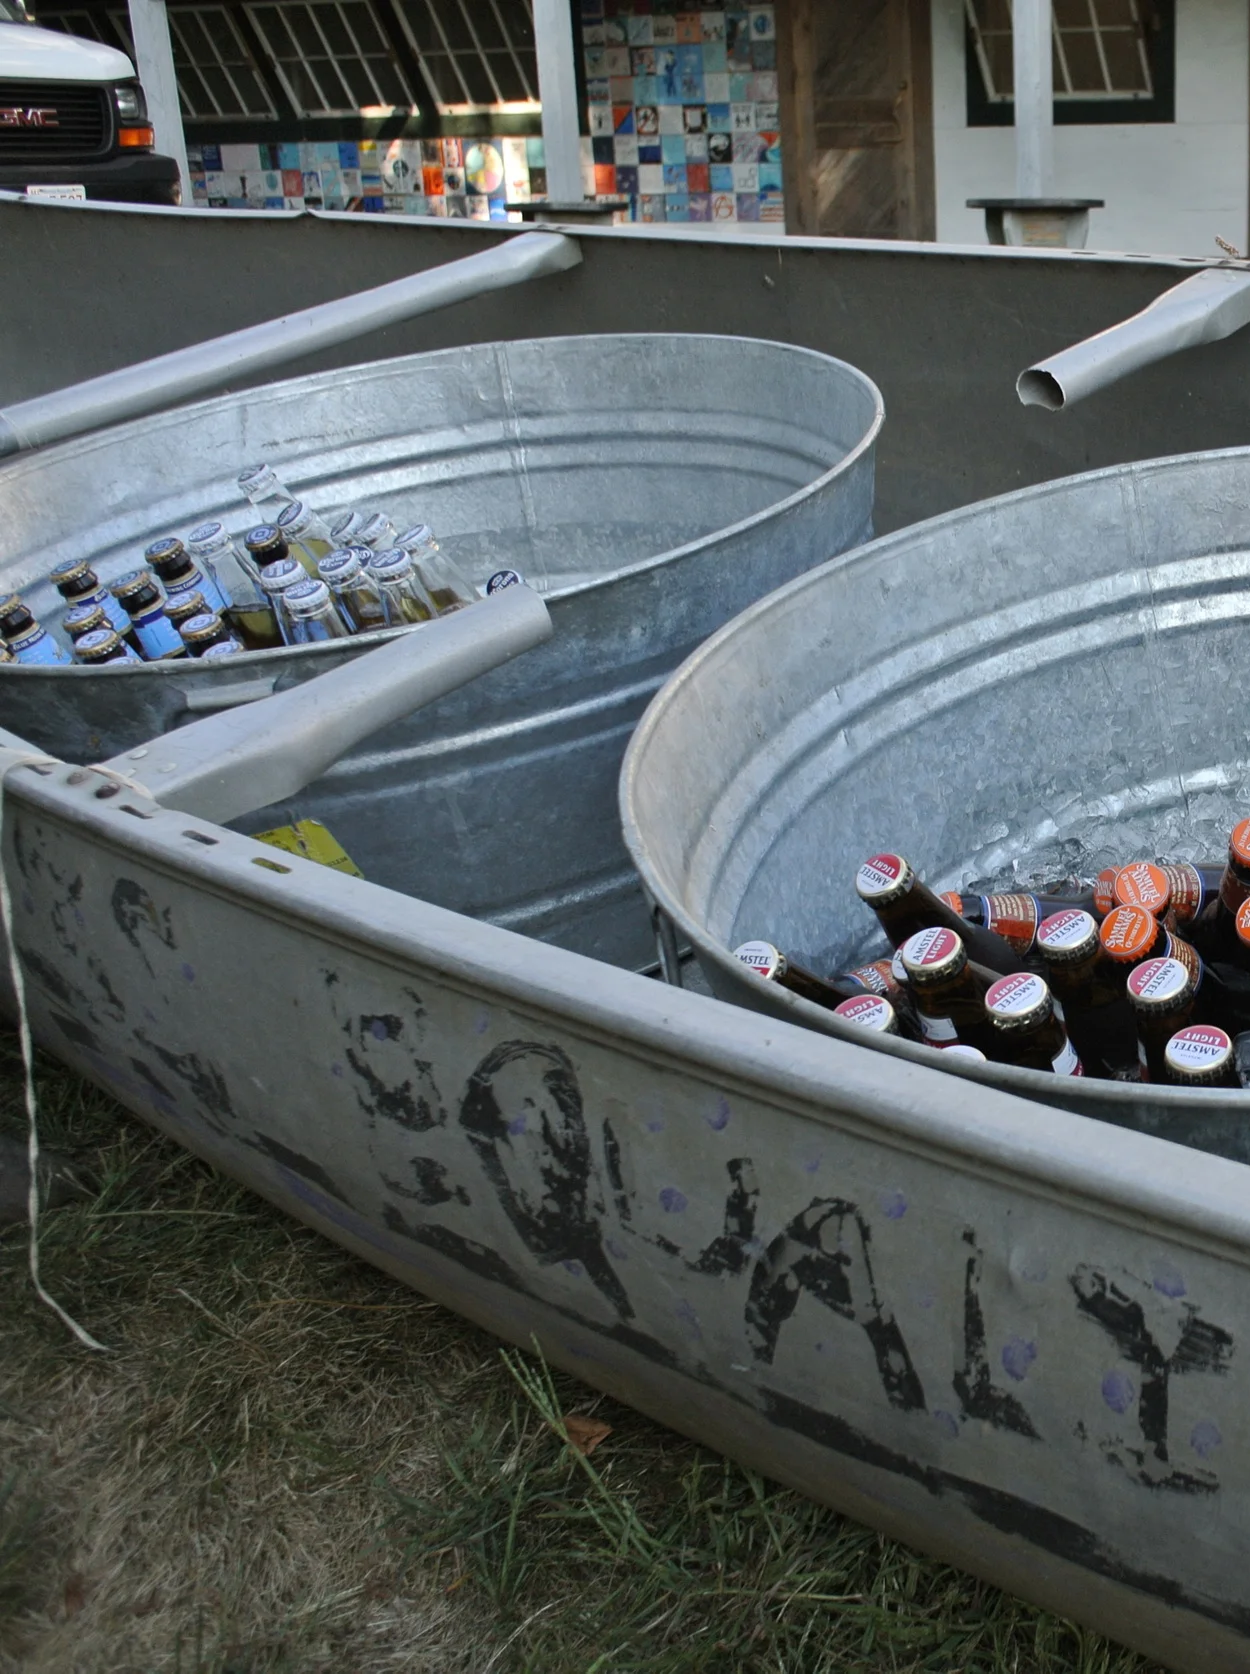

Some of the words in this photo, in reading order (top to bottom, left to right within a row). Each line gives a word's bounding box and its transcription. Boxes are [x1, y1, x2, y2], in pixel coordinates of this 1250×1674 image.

[0, 108, 59, 127] GMC
[861, 866, 890, 886] AMSTEL
[872, 859, 896, 876] LIGHT
[1045, 913, 1075, 935] LIGHT
[1049, 915, 1085, 943] AMSTEL
[913, 928, 938, 961] AMSTEL
[927, 934, 947, 960] LIGHT
[735, 953, 769, 965] MSTEL
[1136, 961, 1162, 987] LIGHT
[1144, 962, 1175, 995] AMSTEL
[994, 977, 1027, 1000] LIGHT
[998, 979, 1036, 1009] AMSTEL
[843, 1000, 876, 1018] LIGH
[853, 1005, 883, 1023] AMS
[1174, 1041, 1220, 1056] AMSTEL
[1184, 1032, 1220, 1046] LIGHT
